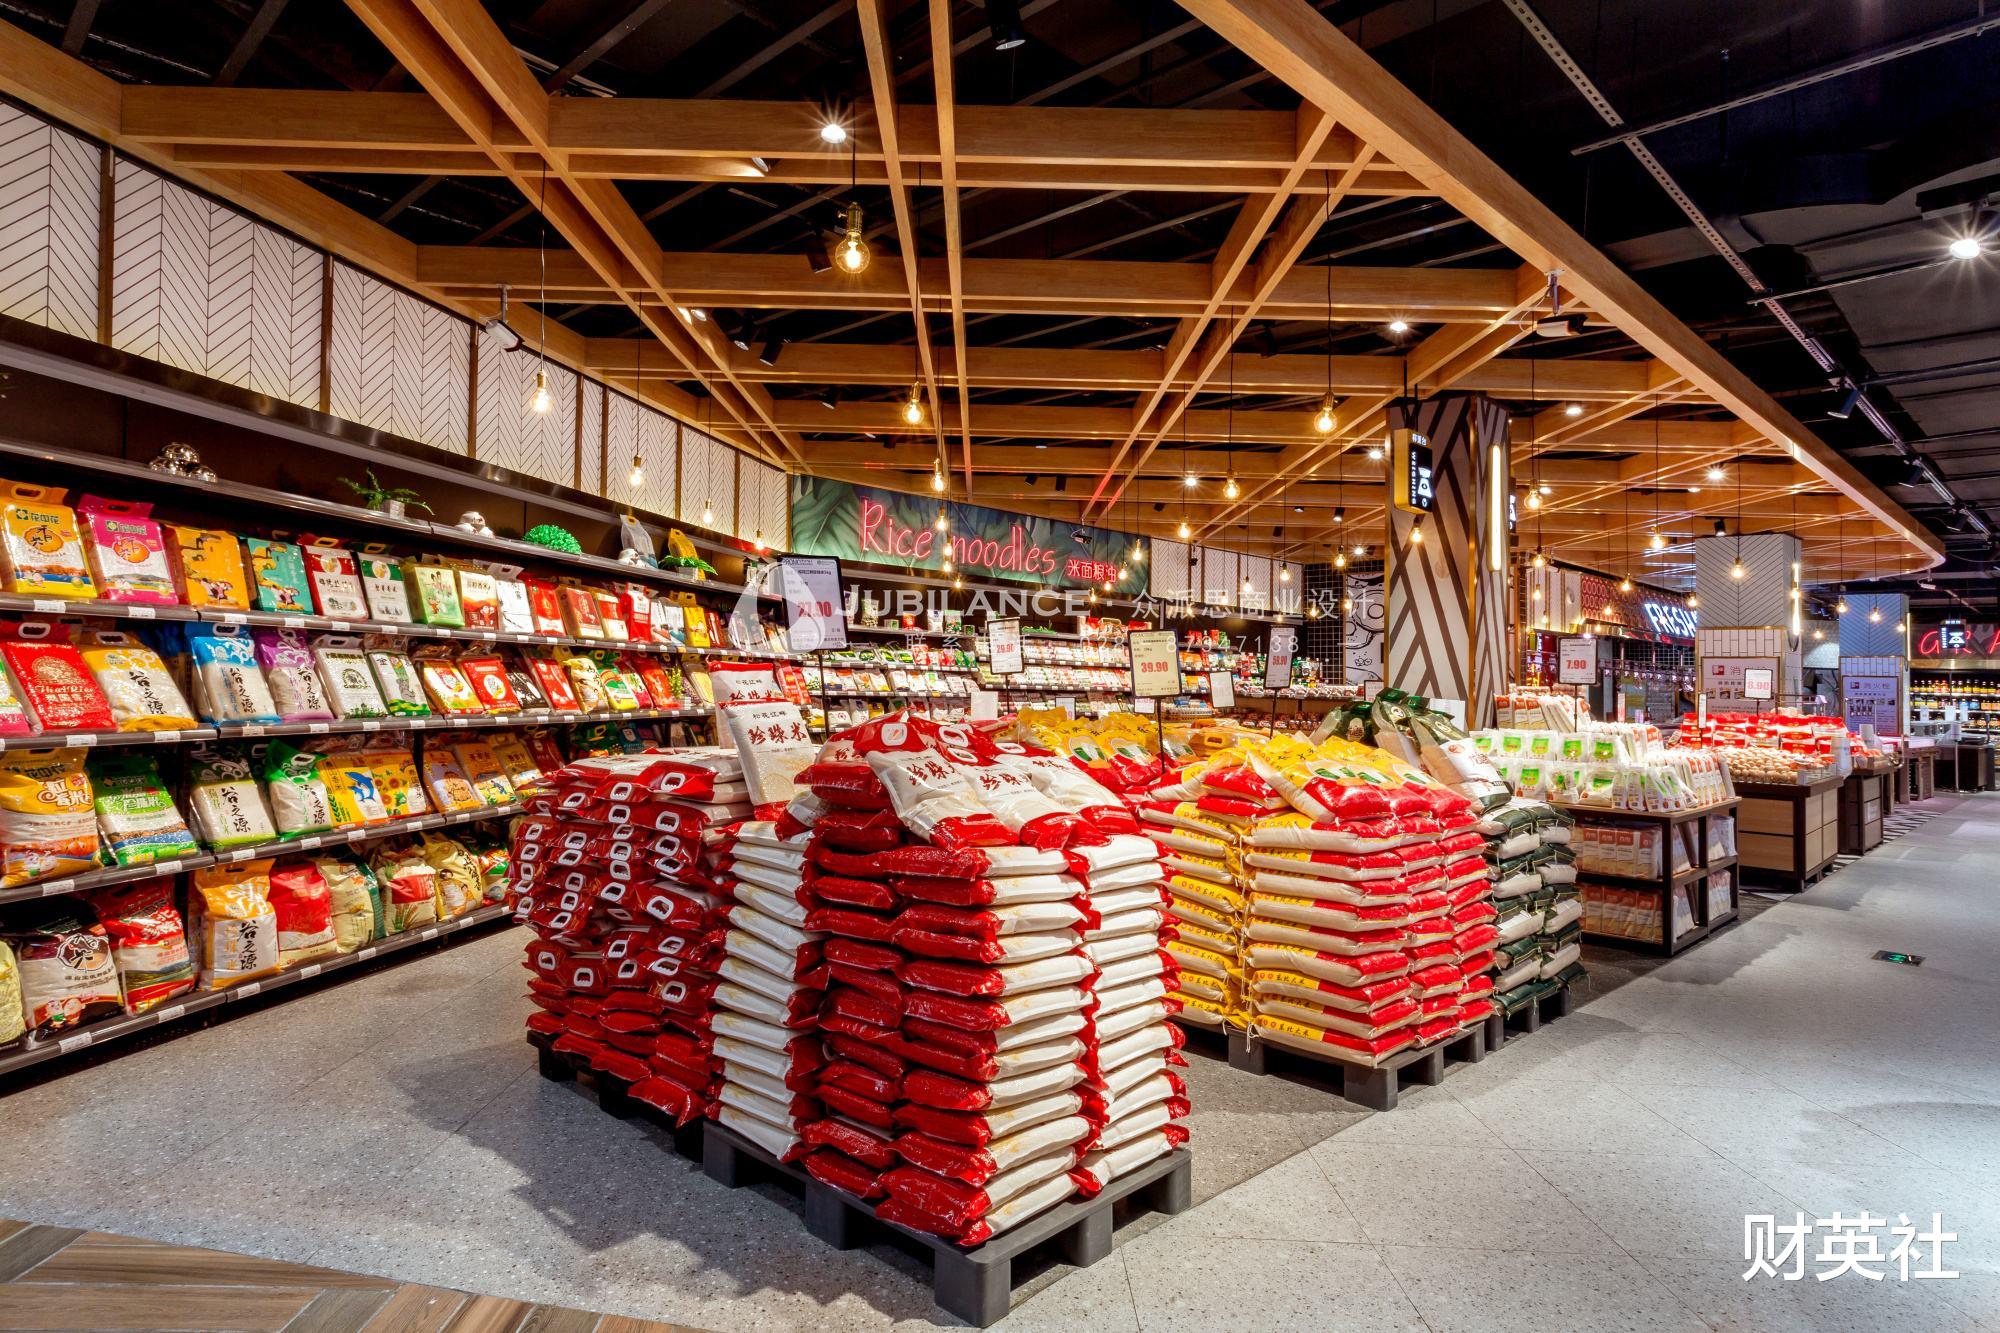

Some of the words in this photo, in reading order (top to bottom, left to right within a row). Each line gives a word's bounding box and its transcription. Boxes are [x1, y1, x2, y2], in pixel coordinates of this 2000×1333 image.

[862, 497, 933, 558] Rice
[951, 526, 1056, 575] noodles
[1068, 559, 1118, 583] 米面粮油
[1141, 661, 1168, 673] 39.90
[1566, 659, 1587, 670] 7.90
[748, 721, 807, 746] 珍珠米
[221, 786, 251, 832] 谷之源
[237, 919, 259, 970] 谷之源
